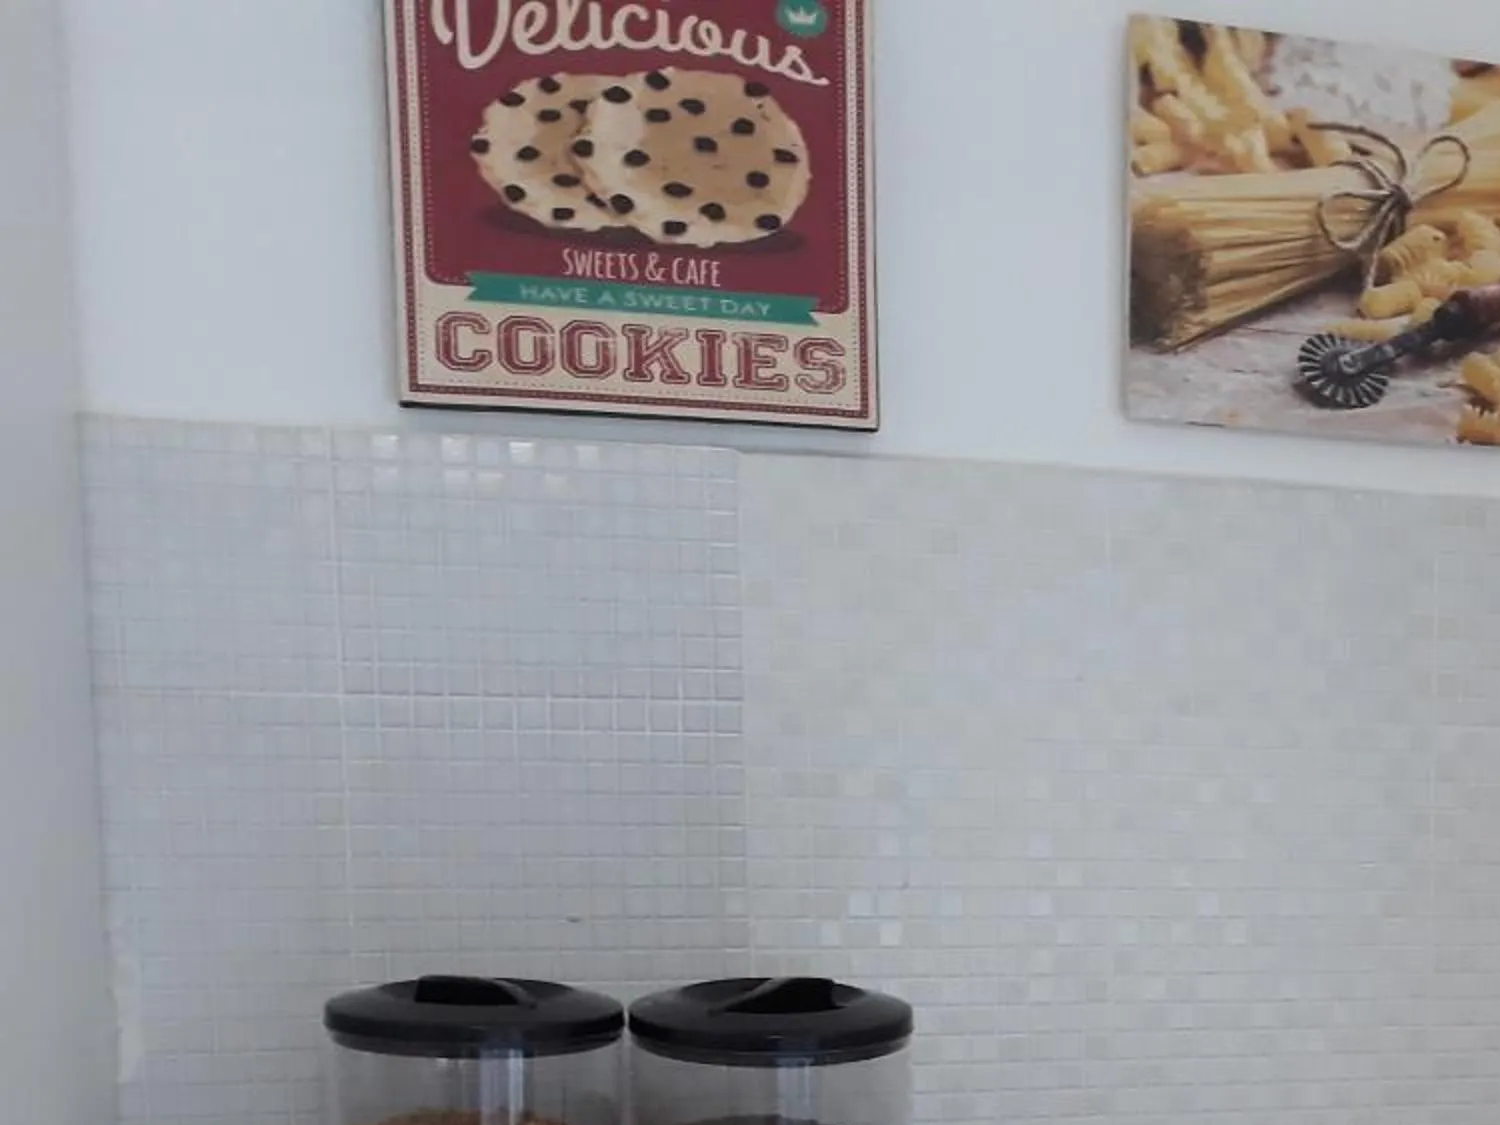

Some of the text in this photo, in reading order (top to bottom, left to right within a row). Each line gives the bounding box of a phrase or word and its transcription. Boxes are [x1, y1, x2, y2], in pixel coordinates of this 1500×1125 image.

[562, 247, 722, 288] SWEETS & CAFE
[519, 284, 772, 317] HAVE A SWEET DAY
[435, 311, 846, 394] COOKIES
